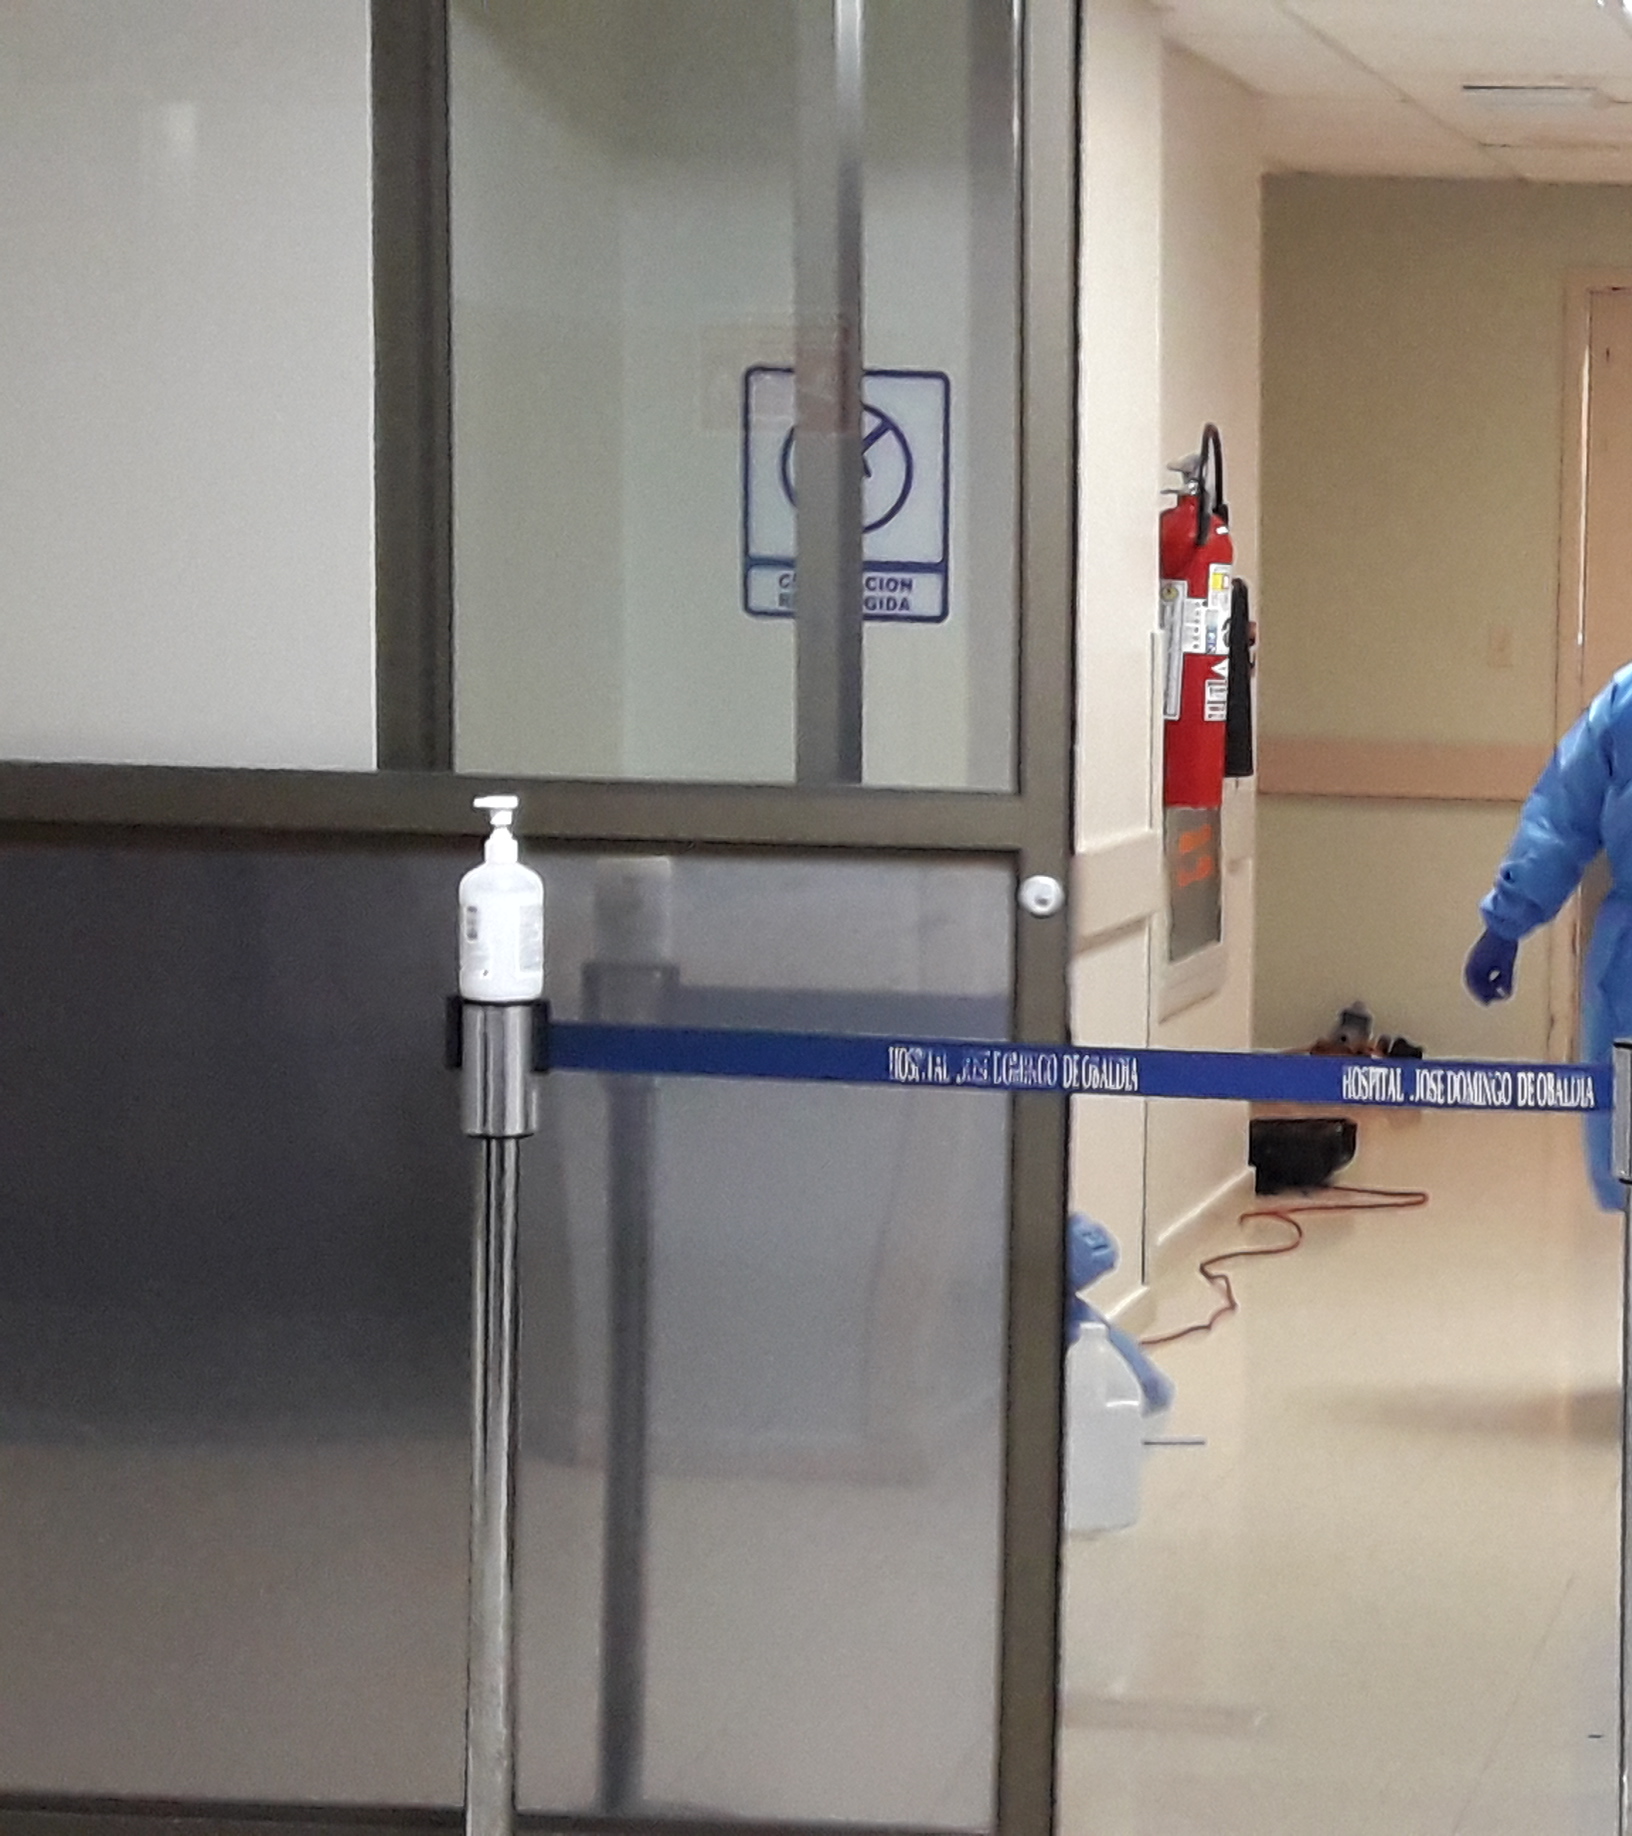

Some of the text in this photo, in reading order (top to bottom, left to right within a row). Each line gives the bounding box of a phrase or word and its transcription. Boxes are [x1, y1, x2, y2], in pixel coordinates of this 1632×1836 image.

[1062, 1053, 1080, 1090] DE
[1342, 1065, 1404, 1101] HOSPITAL
[1446, 1070, 1513, 1107] DOMINGO
[1516, 1071, 1535, 1107] DE
